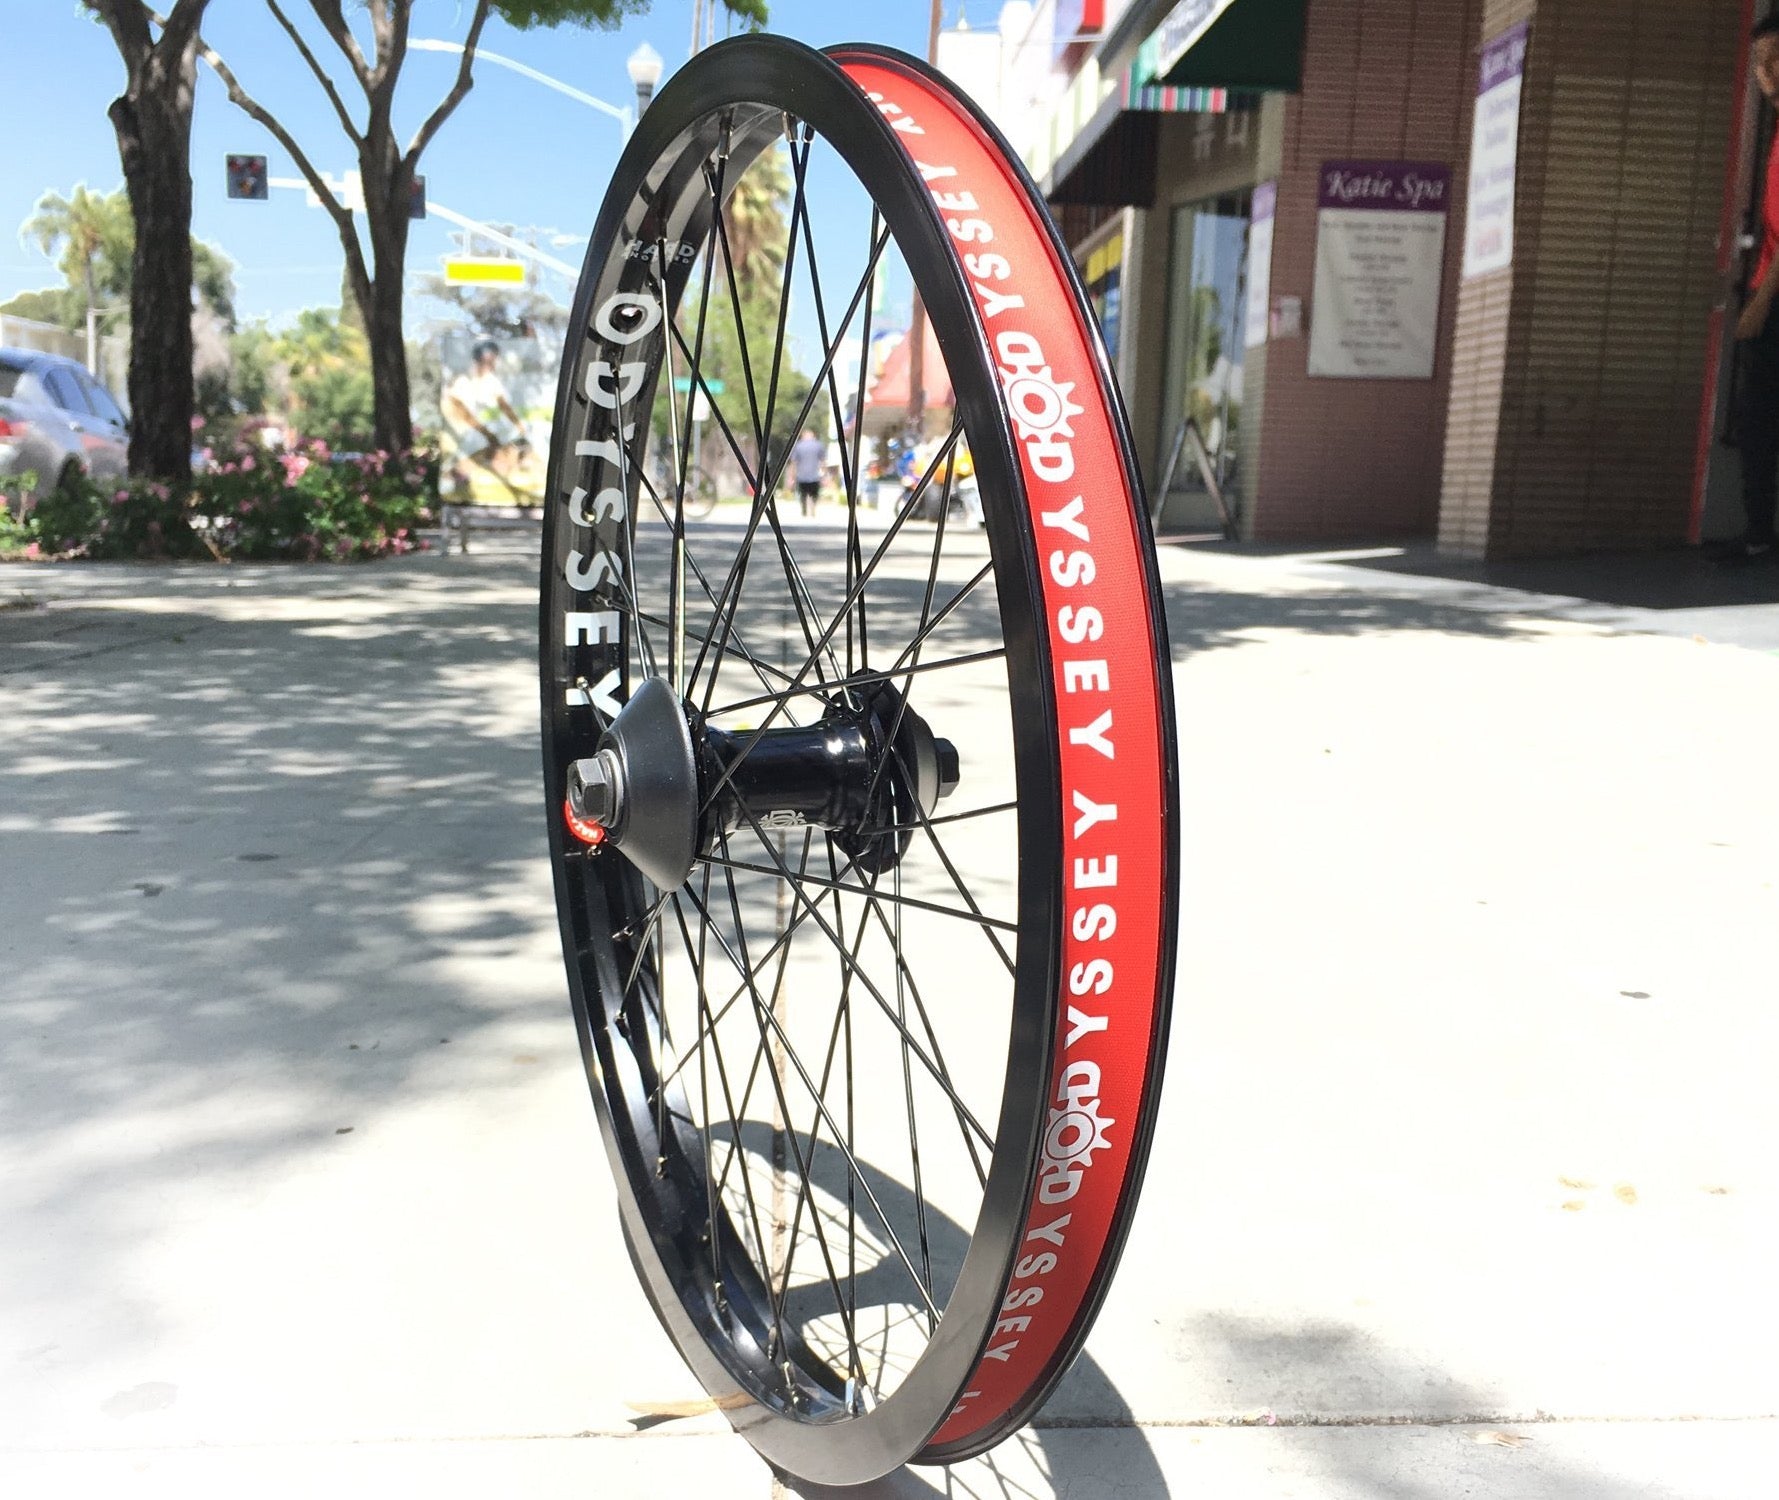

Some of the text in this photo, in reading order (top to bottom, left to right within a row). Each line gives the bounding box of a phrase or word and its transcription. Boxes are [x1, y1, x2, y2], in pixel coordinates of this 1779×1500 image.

[1326, 169, 1445, 208] Katie Spa
[565, 292, 663, 719] ODYSSEY
[1001, 368, 1115, 760] ODYSSEY
[1040, 789, 1119, 1175] ODYSSEY
